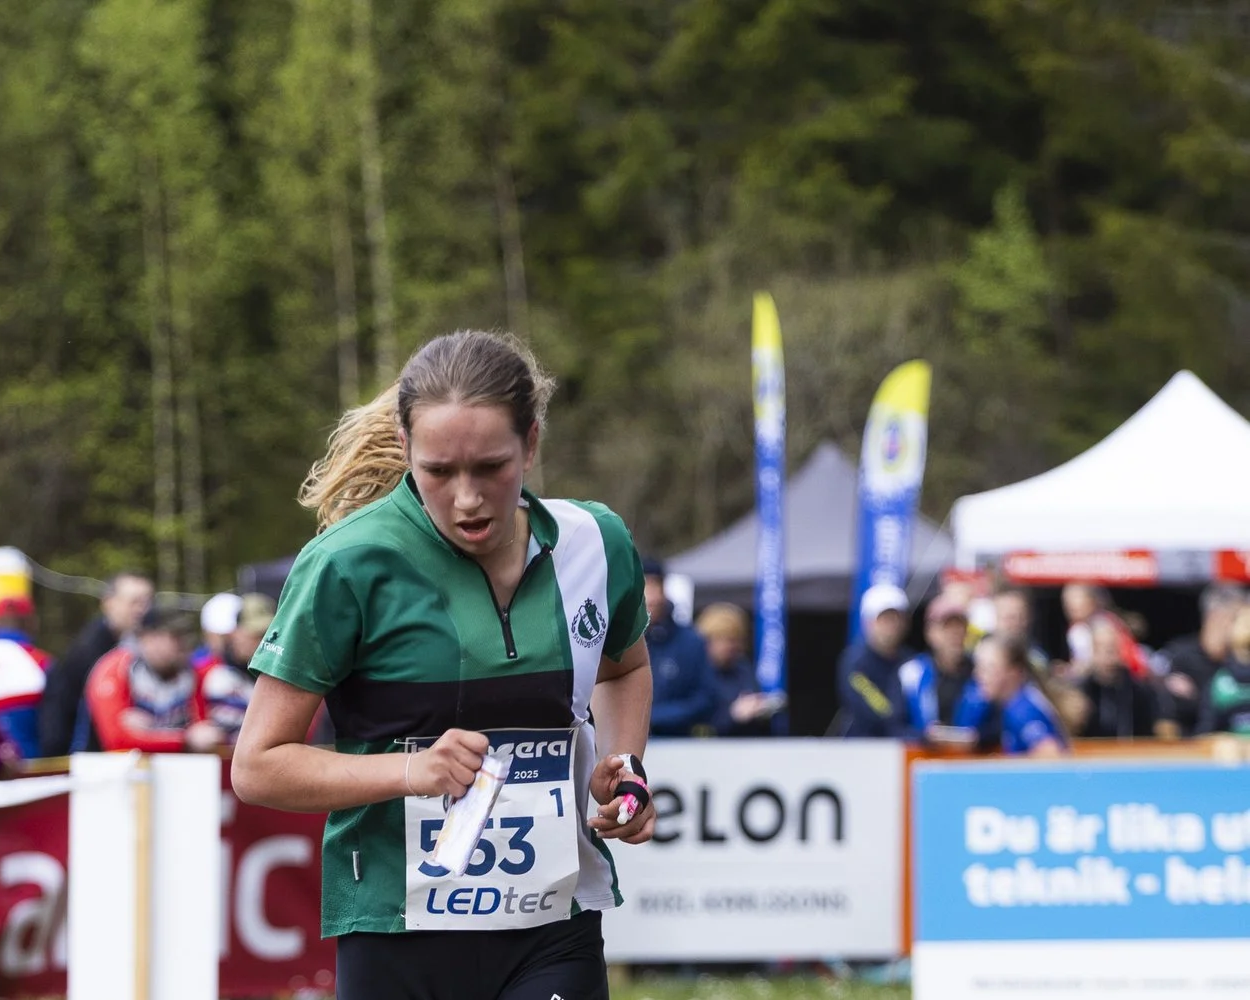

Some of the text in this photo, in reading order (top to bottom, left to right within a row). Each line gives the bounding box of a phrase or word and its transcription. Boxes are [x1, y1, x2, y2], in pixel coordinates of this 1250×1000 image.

[514, 770, 539, 779] 2025
[549, 788, 564, 817] 1
[964, 805, 1040, 854] Du
[962, 856, 1132, 907] teknik
